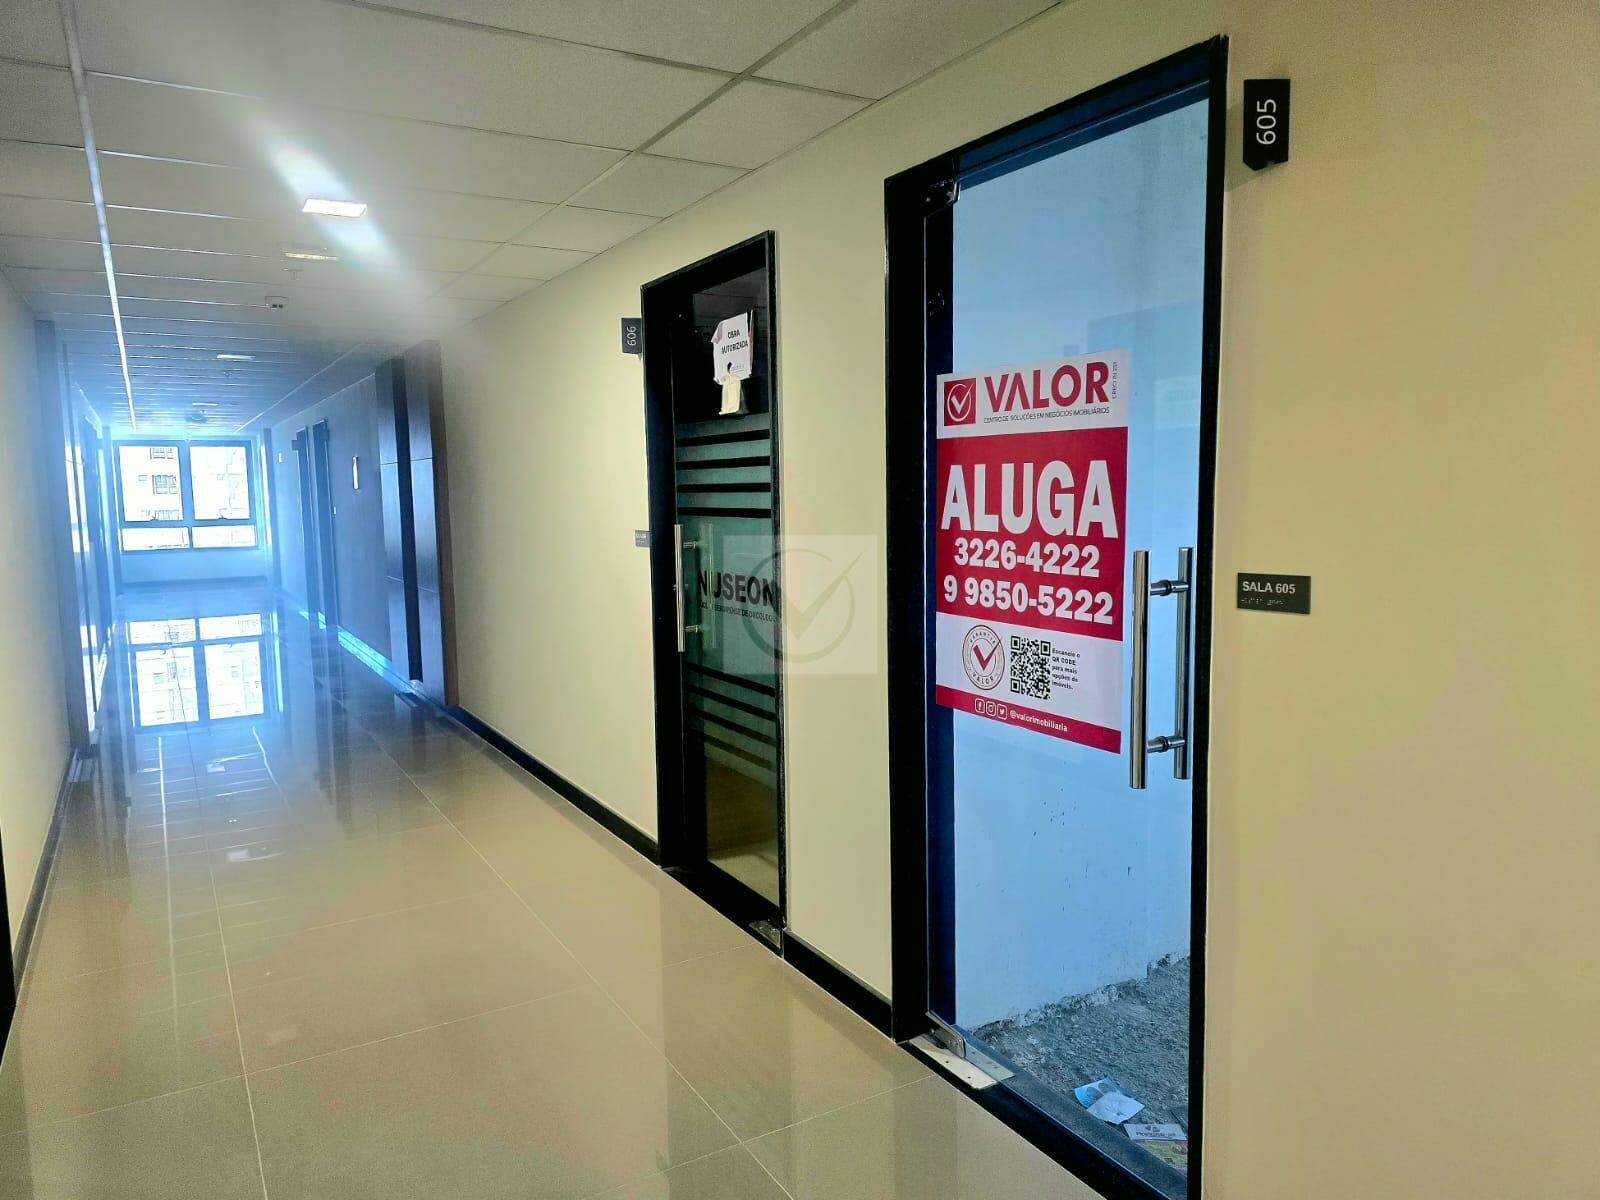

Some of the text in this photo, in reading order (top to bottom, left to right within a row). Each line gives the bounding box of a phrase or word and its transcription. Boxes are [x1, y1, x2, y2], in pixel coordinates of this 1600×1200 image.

[1256, 99, 1277, 145] 605
[626, 325, 637, 347] 606
[727, 329, 740, 339] OBRA
[721, 340, 749, 354] AUTORIZADA
[984, 361, 1110, 413] VALOR
[1045, 410, 1073, 418] NEGÓCIOS
[1073, 406, 1110, 416] IMOBILIÁRIOS
[941, 460, 1118, 539] ALUGA
[954, 537, 1100, 578] 3226-4222
[1242, 581, 1296, 594] SALA 605
[943, 574, 1113, 625] 9 9850-5222
[1061, 657, 1076, 666] CODE
[1009, 709, 1068, 732] @valorimobiliaria
